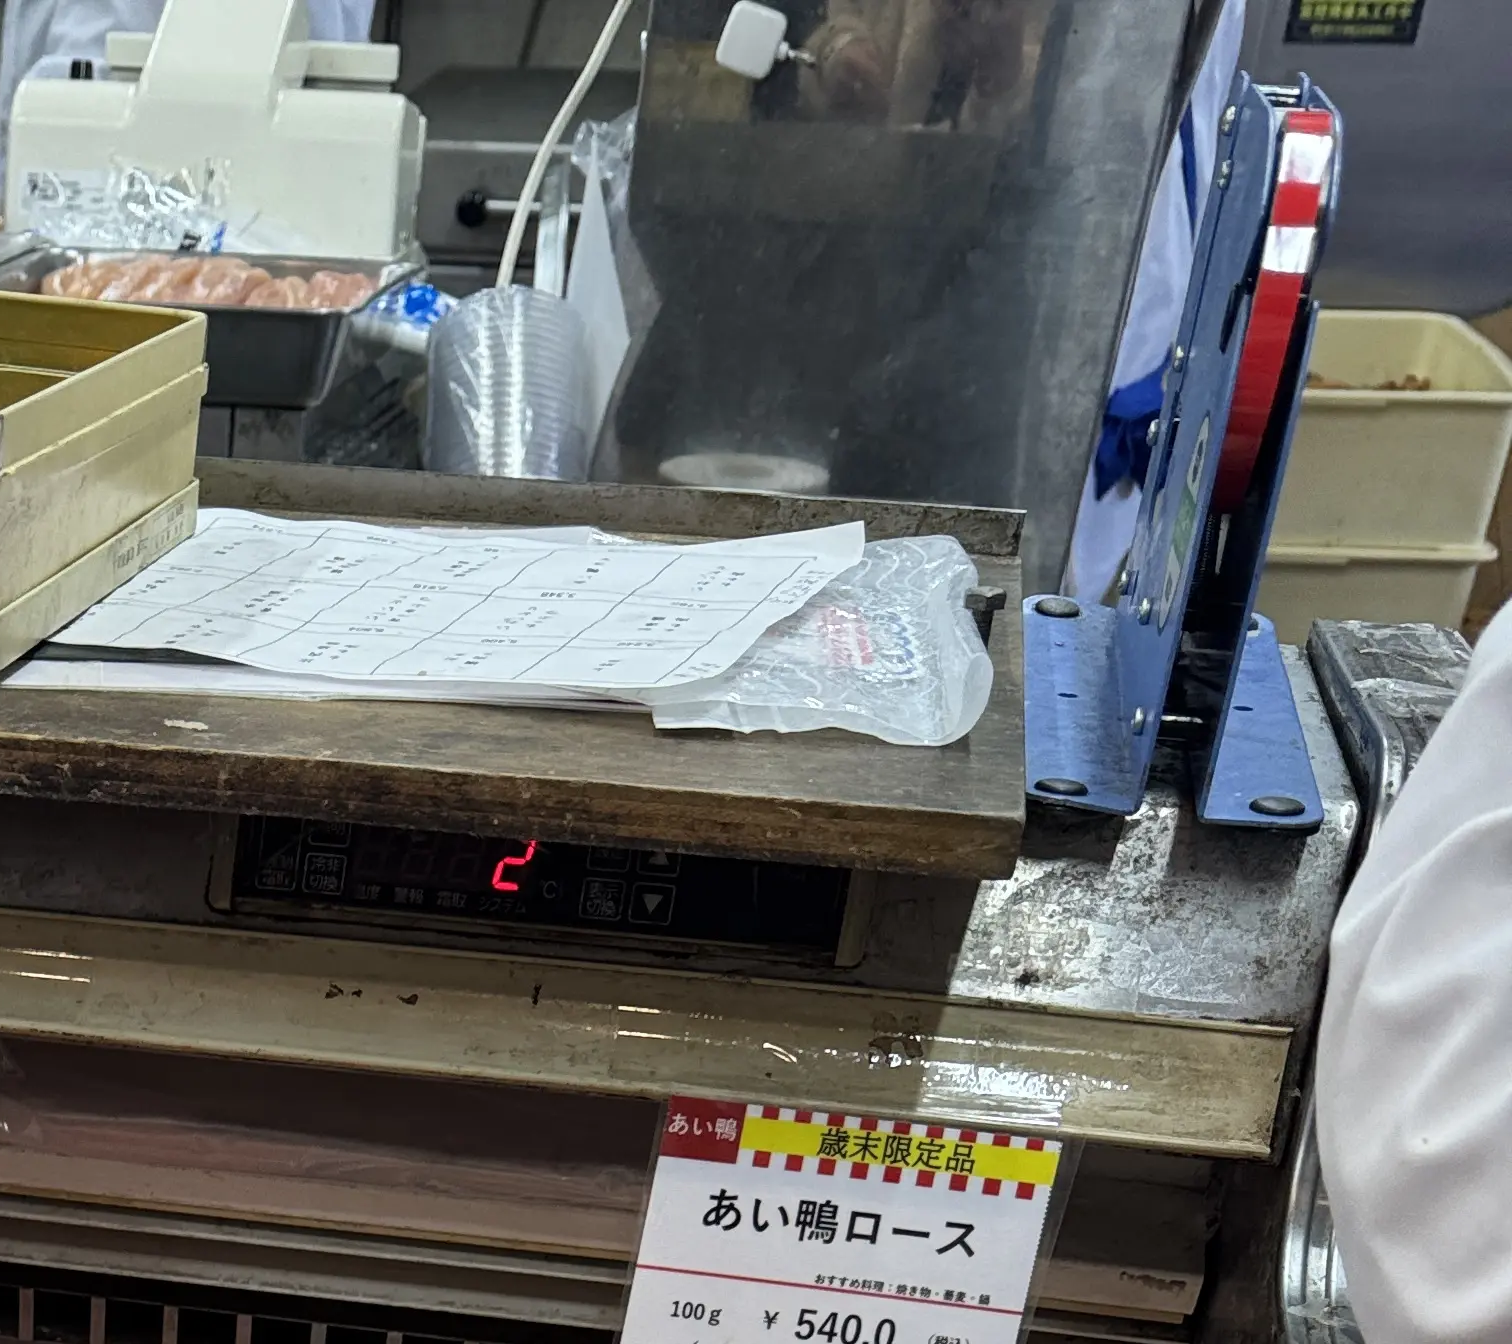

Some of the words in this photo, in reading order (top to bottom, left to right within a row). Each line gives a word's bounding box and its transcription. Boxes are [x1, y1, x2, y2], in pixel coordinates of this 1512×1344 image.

[667, 1112, 737, 1143] あい鴨
[816, 1126, 977, 1176] 歳末限定品
[701, 1188, 976, 1258] あい鴨ロース
